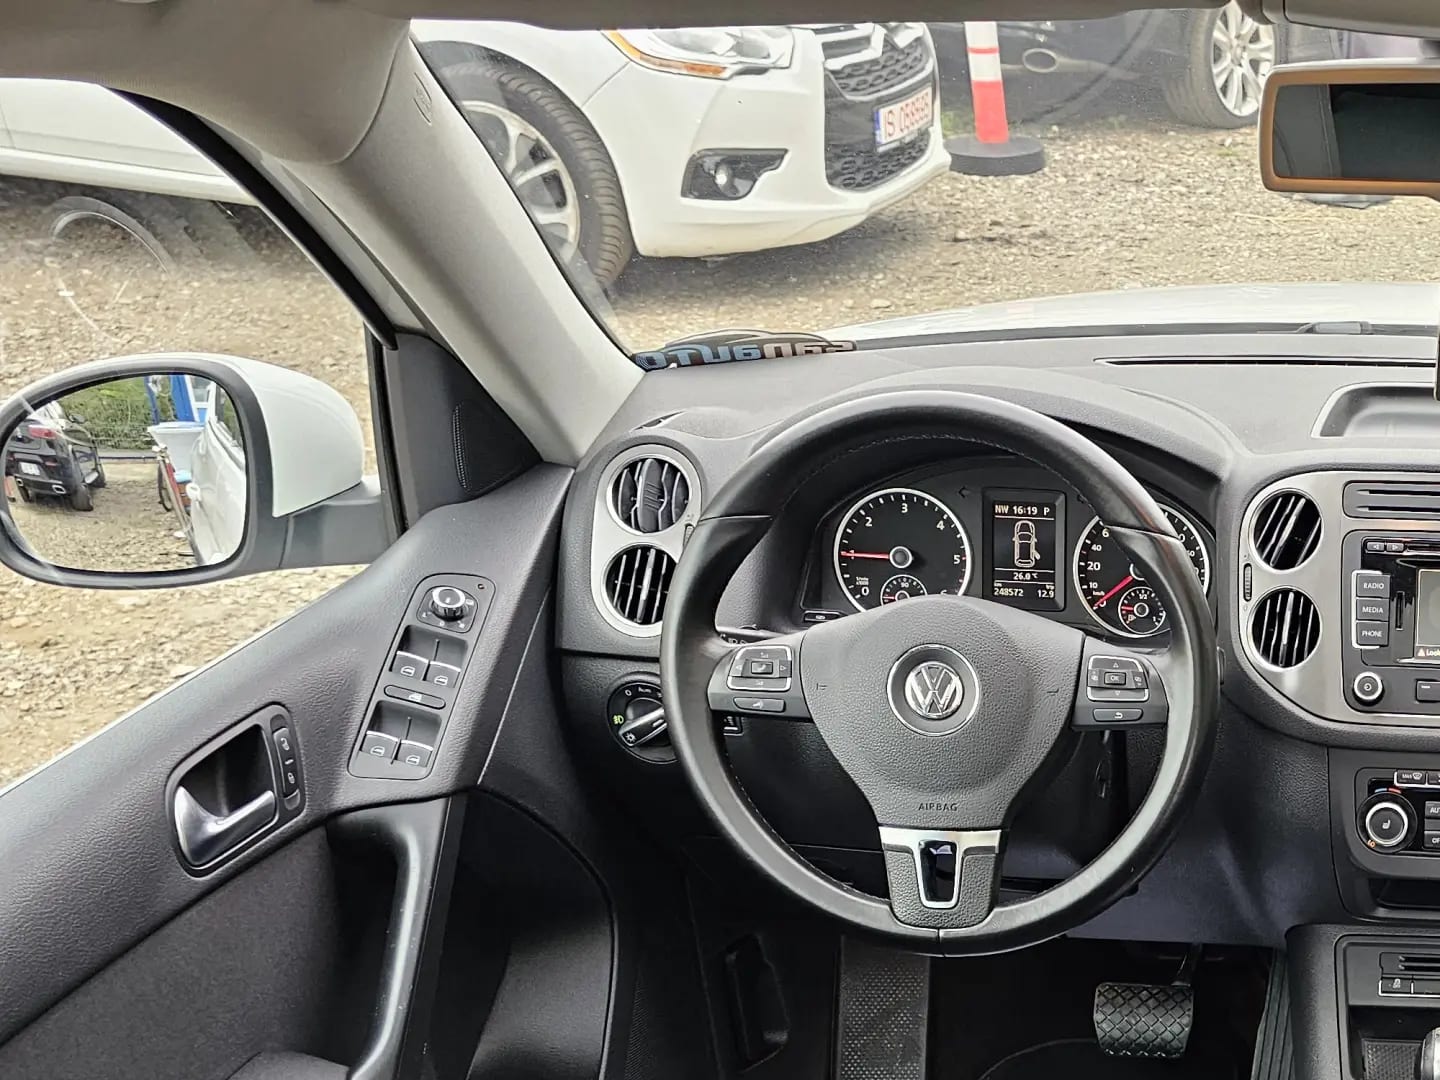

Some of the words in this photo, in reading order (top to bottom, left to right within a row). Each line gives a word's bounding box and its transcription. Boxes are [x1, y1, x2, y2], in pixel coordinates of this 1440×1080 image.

[901, 503, 908, 513] 3
[995, 505, 1009, 513] NW
[1013, 506, 1037, 515] 16:19
[1044, 507, 1050, 516] P
[865, 517, 872, 527] 2
[936, 520, 945, 530] 4
[954, 555, 960, 564] 5
[1087, 562, 1100, 571] 20
[861, 586, 869, 595] 0
[994, 588, 1023, 596] 248572
[1038, 590, 1054, 598] 12.9
[918, 803, 958, 812] AIRBAG
